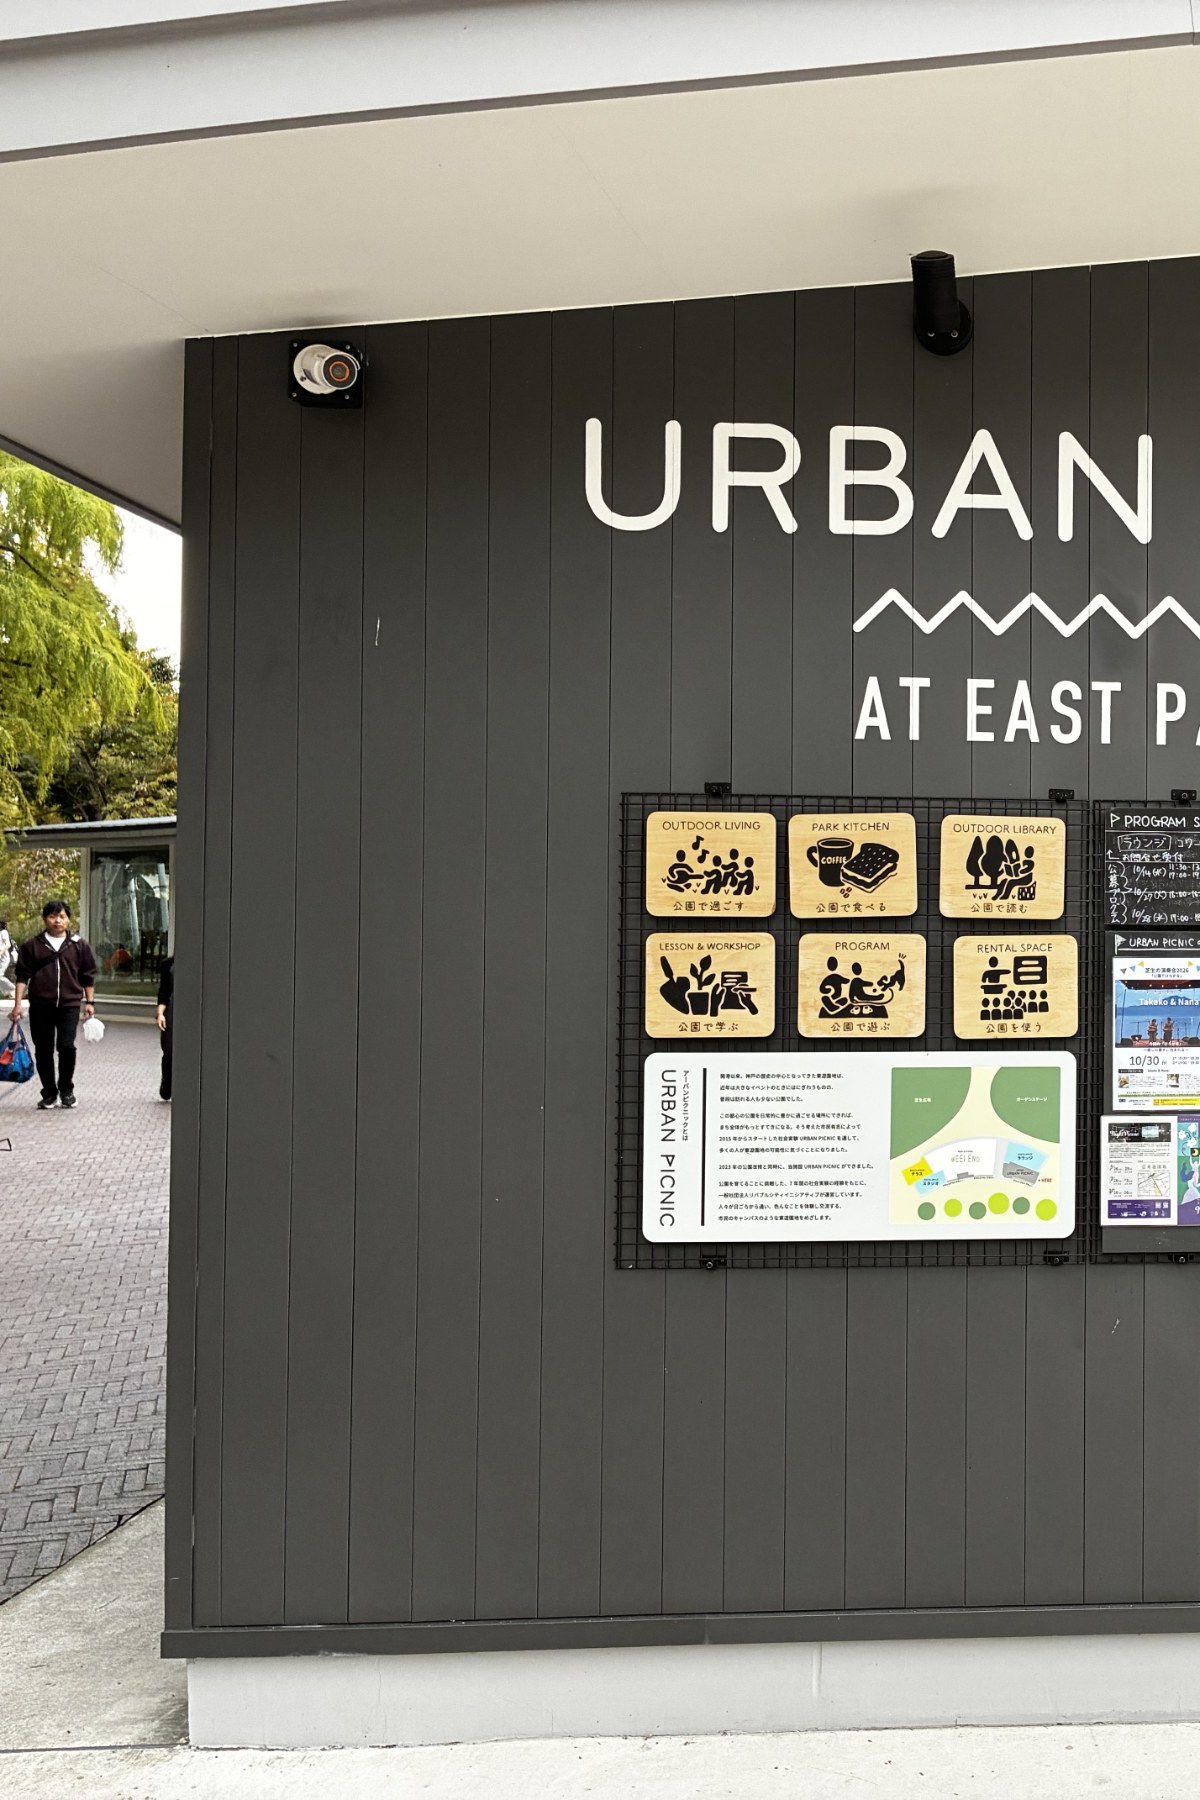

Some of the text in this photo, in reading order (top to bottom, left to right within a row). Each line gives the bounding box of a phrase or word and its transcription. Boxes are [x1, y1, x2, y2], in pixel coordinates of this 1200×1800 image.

[585, 417, 1152, 544] URBAN
[854, 676, 930, 740] AT
[966, 678, 1121, 744] EAST
[662, 820, 761, 831] OUTDOOR LIVING
[812, 822, 890, 832] PARK KITCHEN
[1124, 815, 1186, 828] PROGRAM
[953, 823, 1057, 834] OUTDOOR LIBRARY
[1123, 837, 1167, 849] ラウンジ
[673, 901, 745, 912] 公園で過ごす
[815, 902, 886, 913] 公園で食べる
[971, 902, 1028, 914] 公園で読む
[659, 942, 761, 951] LESSON & WORKSHOP
[835, 941, 890, 951] PROGRAM
[1129, 937, 1159, 947] URBAN
[977, 943, 1053, 954] RENTAL SPACE
[1139, 998, 1168, 1006] Takako
[1178, 998, 1200, 1006] Nana
[678, 1021, 739, 1033] 公園で学ぶ
[830, 1021, 890, 1033] 公園で遊ぶ
[986, 1022, 1042, 1034] 公園を使う
[1129, 1056, 1160, 1067] 10/30
[659, 1069, 677, 1226] URBAN PICNIC
